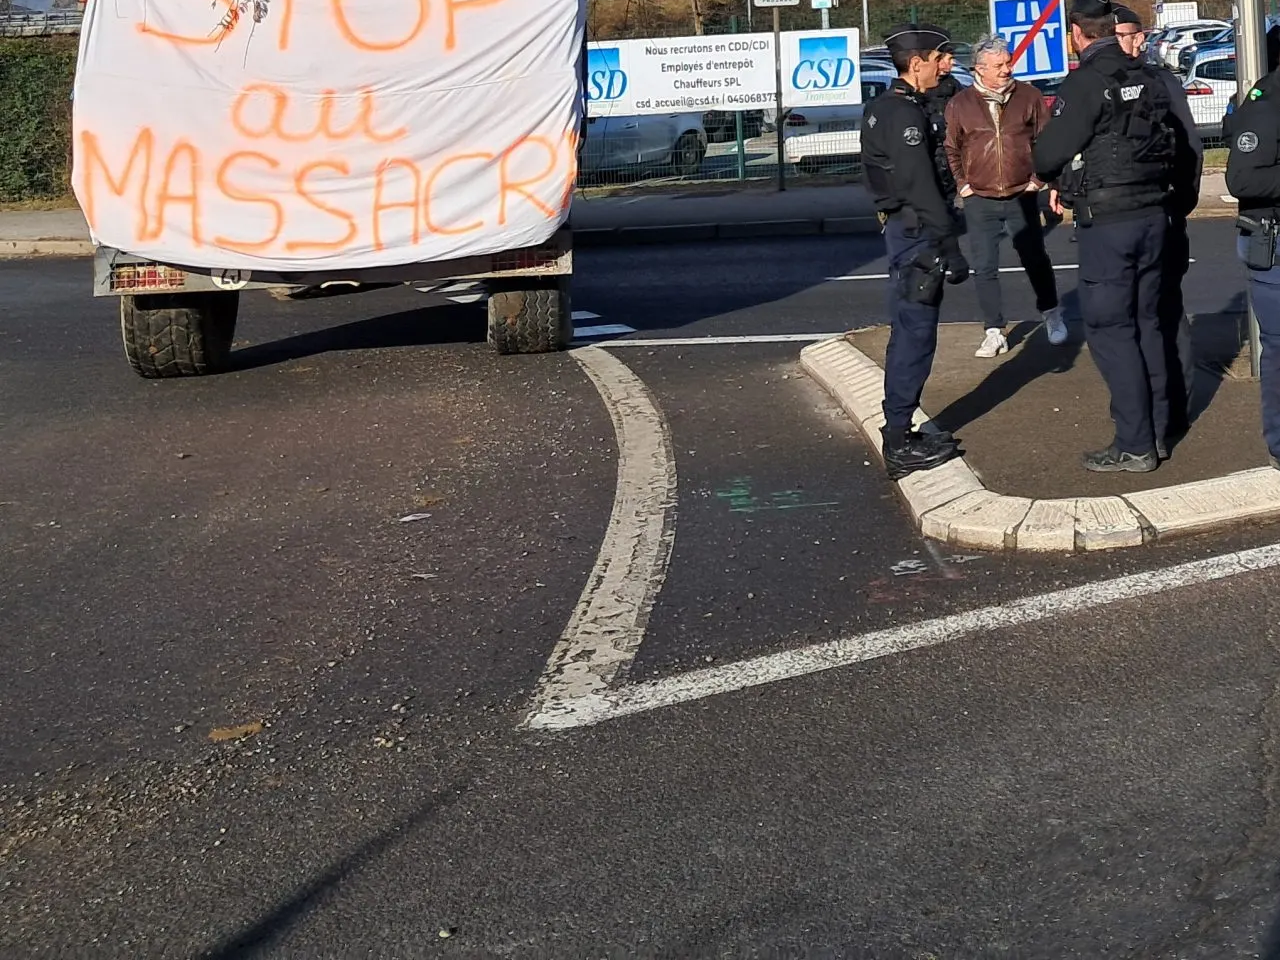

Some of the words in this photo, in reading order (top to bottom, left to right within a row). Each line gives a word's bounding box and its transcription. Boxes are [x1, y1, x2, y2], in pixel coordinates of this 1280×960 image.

[645, 45, 668, 56] Nous
[670, 43, 713, 54] recrutons
[715, 43, 726, 52] en
[728, 39, 770, 52] CDD/CDI
[661, 62, 704, 74] Employés
[705, 58, 754, 71] d'entrepôt
[792, 57, 855, 90] CSD
[673, 80, 722, 90] Chauffeurs
[724, 76, 742, 87] SPL
[230, 82, 406, 142] au
